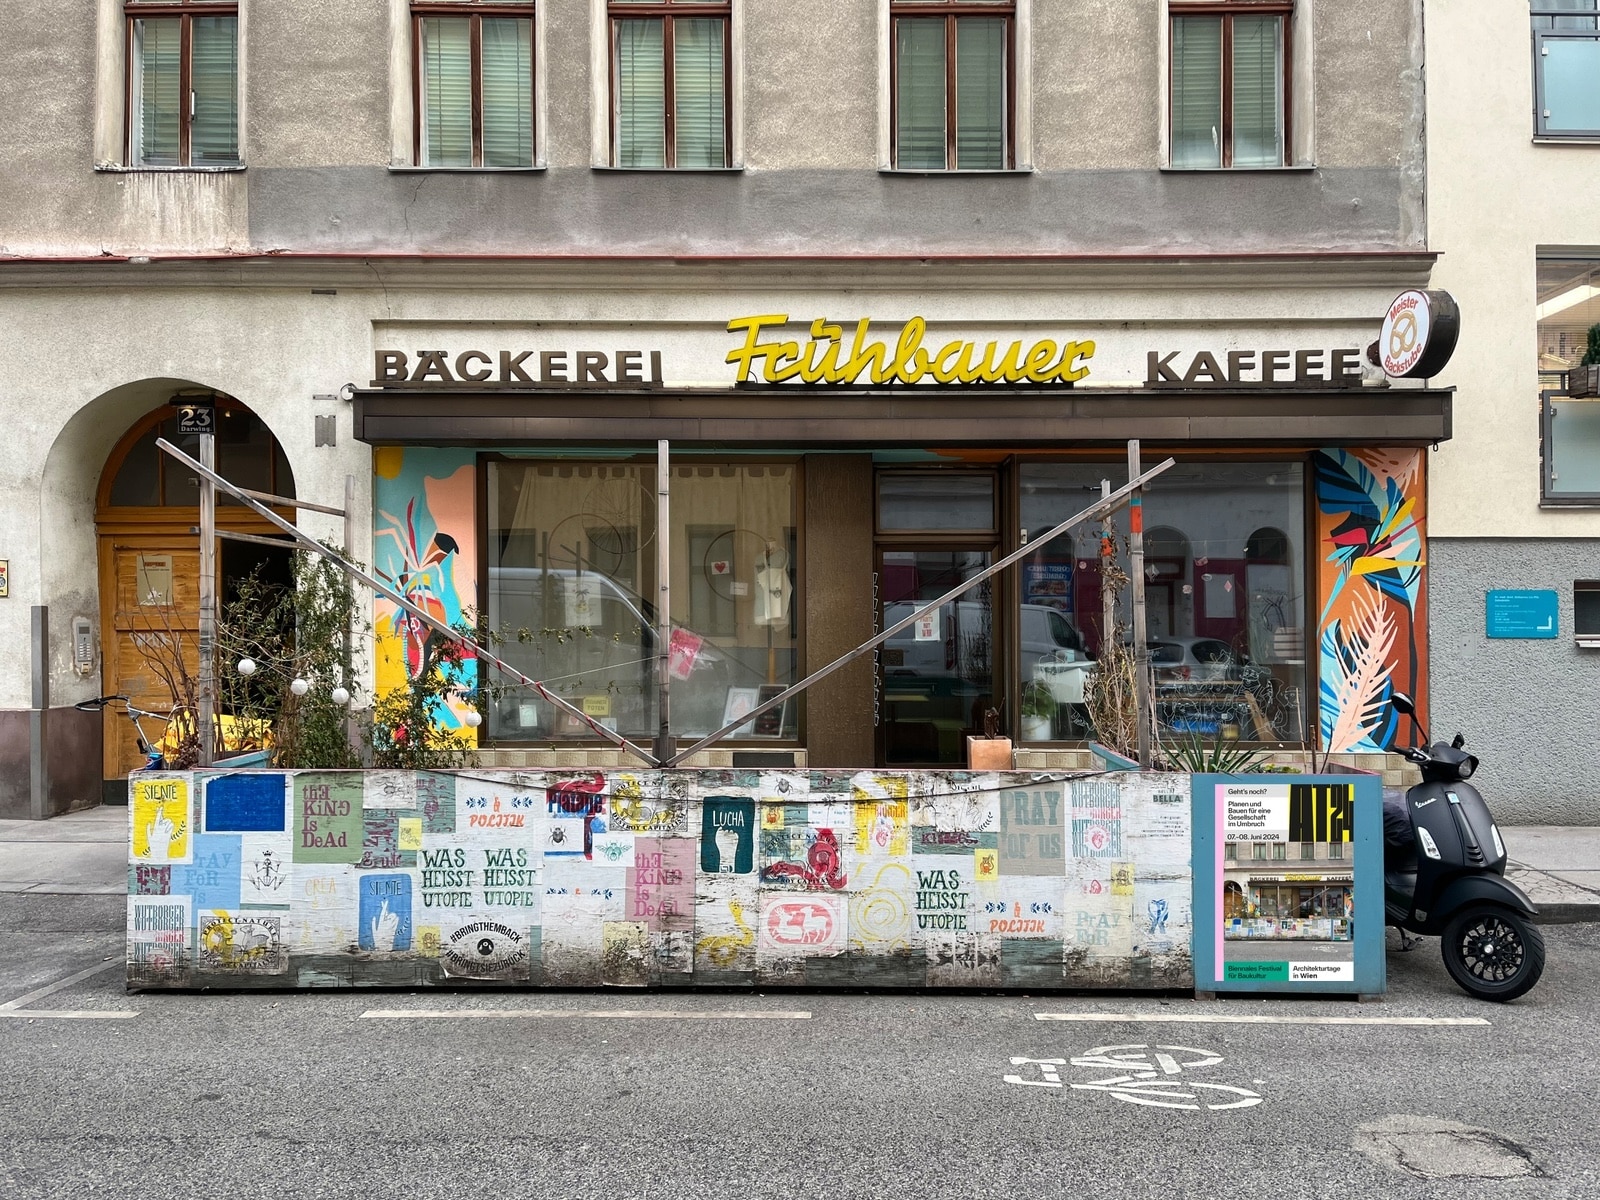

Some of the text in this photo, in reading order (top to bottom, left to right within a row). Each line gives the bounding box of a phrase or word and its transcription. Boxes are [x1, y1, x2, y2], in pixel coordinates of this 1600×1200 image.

[1389, 295, 1419, 322] Meister
[725, 313, 1096, 384] Frühbauer
[1384, 343, 1422, 373] Backstube
[375, 350, 662, 382] BÄCKEREI
[1147, 349, 1361, 383] KAFFEE
[181, 408, 211, 427] 23
[144, 784, 178, 800] SIENTE
[1153, 795, 1181, 803] BELLA
[469, 814, 525, 828] POLITIK
[712, 809, 745, 827] LUCHA
[422, 848, 465, 868] WAS
[484, 848, 528, 868] WAS
[369, 880, 403, 896] SIENTE
[421, 869, 474, 888] HEISST
[483, 869, 536, 888] HEISST
[917, 870, 960, 890] WAS
[423, 891, 472, 908] UTOPIE
[484, 891, 534, 908] UTOPIE
[916, 891, 968, 910] HEISST
[917, 914, 967, 930] UTOPIE
[990, 919, 1046, 933] POLITIK
[449, 921, 523, 944] #BRINGTHEMBACK
[445, 949, 526, 973] #BRINGTSIEZURÜCK
